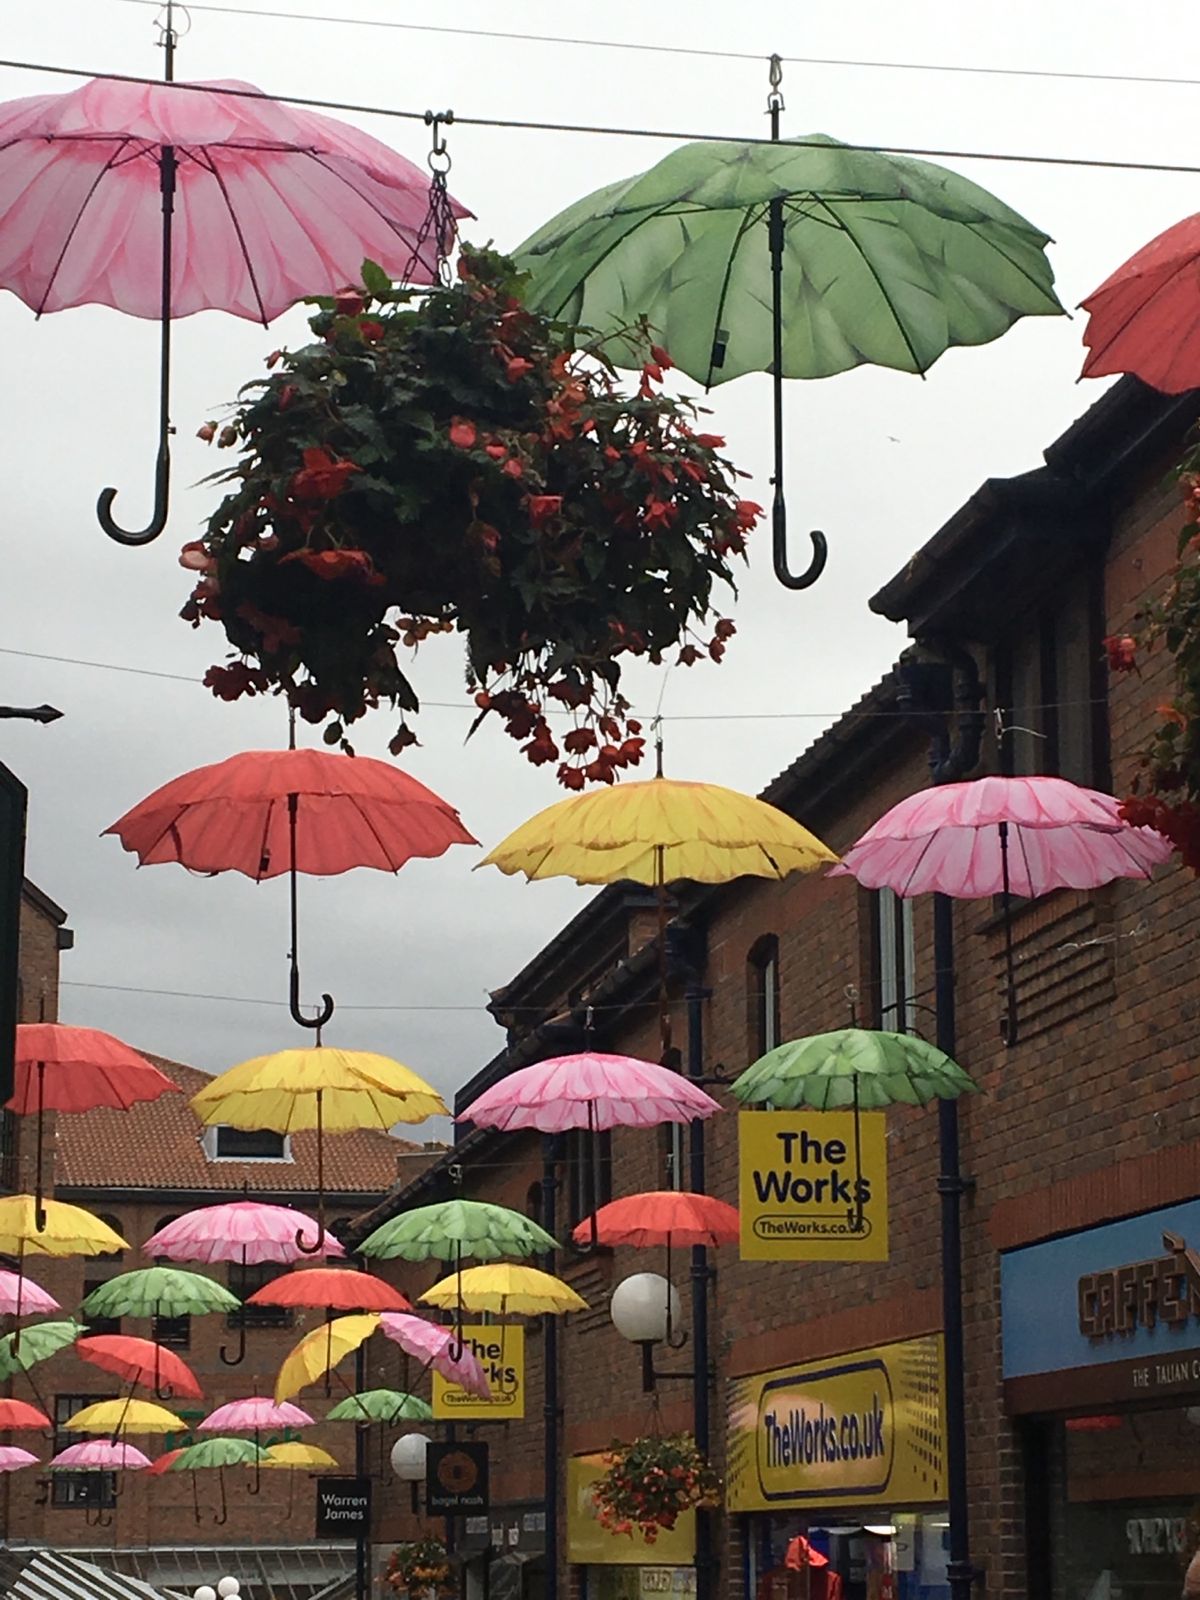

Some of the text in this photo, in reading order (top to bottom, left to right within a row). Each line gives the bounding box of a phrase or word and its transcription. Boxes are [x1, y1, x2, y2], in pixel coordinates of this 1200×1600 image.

[777, 1130, 846, 1164] The
[753, 1169, 871, 1204] Works
[462, 1339, 500, 1359] he
[1132, 1368, 1149, 1388] THE
[764, 1391, 885, 1468] TheWorks.co.uk
[322, 1494, 367, 1506] Warren
[324, 1508, 364, 1520] James
